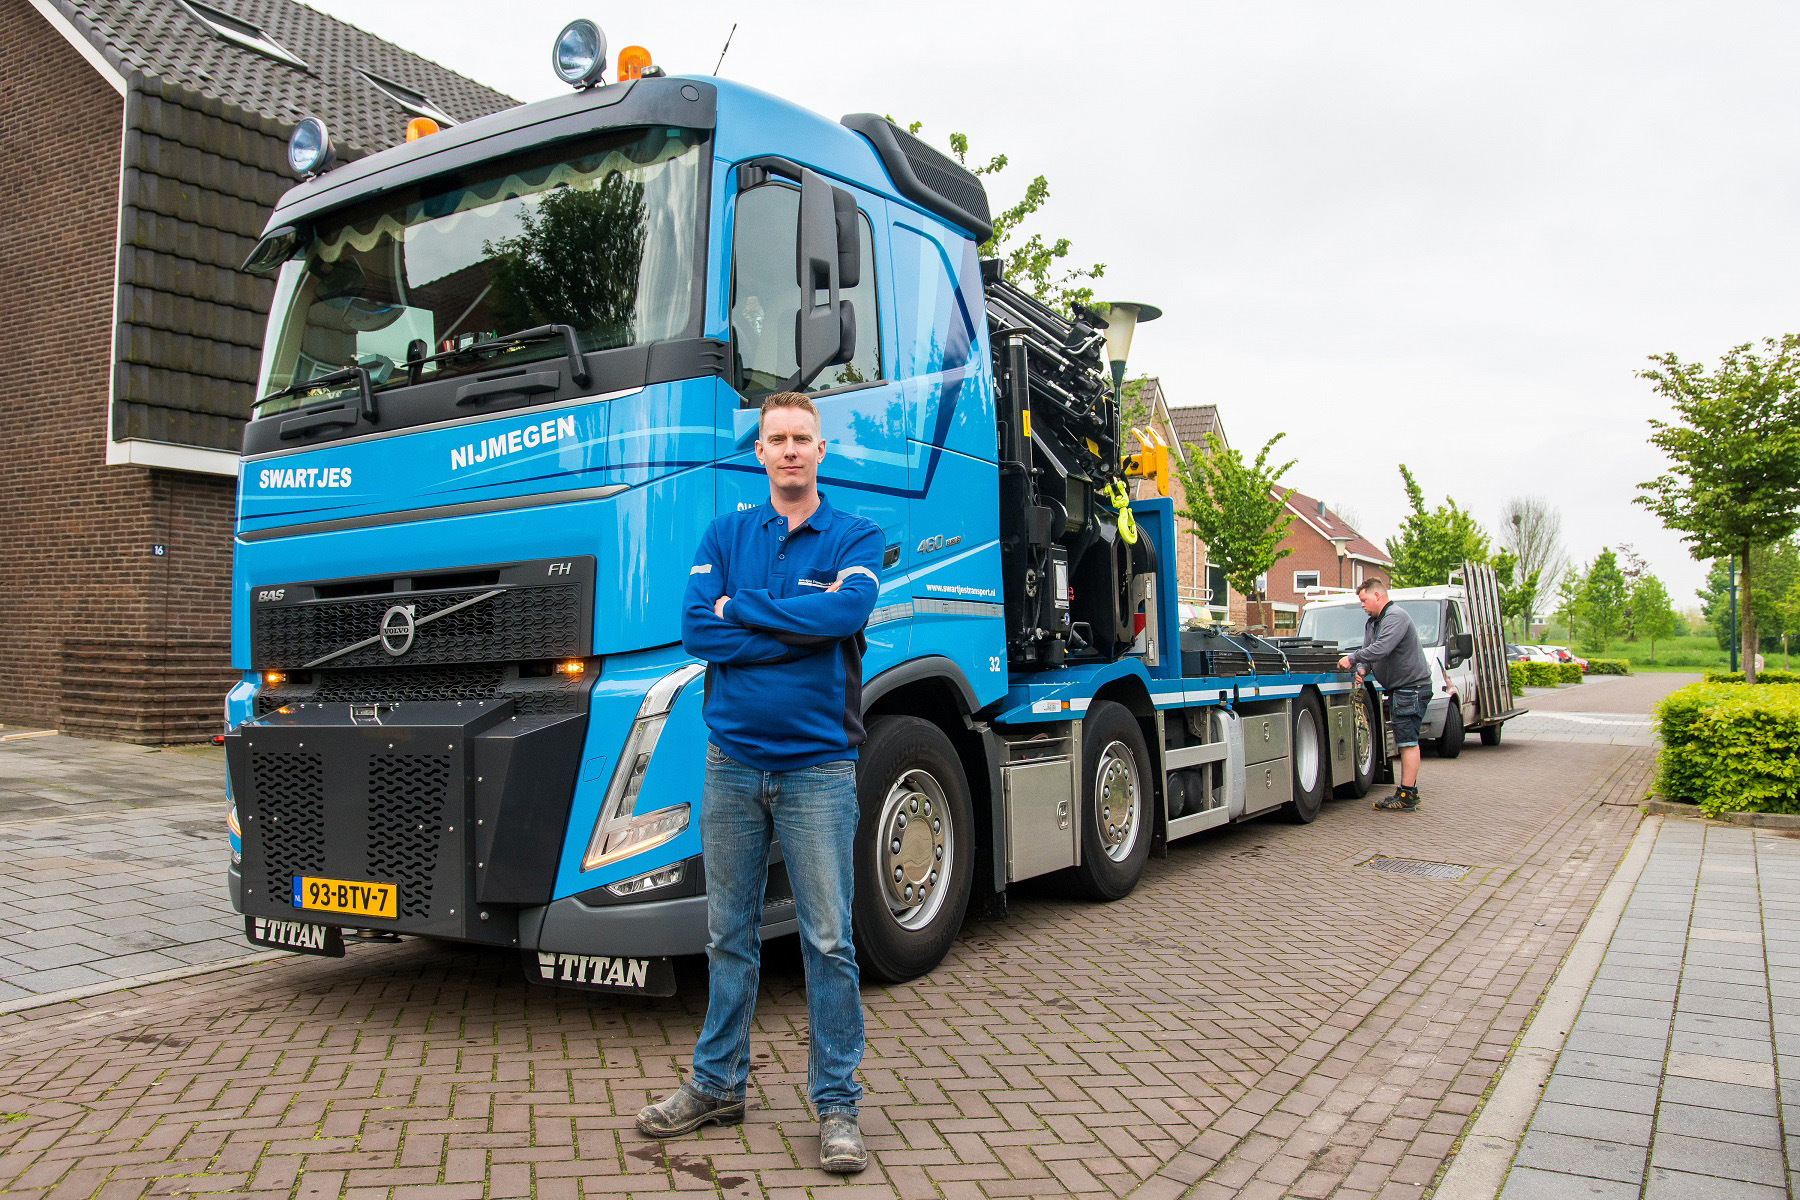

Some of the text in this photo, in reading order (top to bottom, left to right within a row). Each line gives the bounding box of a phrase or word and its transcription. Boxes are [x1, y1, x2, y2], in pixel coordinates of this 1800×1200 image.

[451, 415, 575, 470] NIJMEGEN
[259, 467, 352, 488] SWARTJES
[154, 545, 164, 555] 16
[917, 534, 944, 554] 460
[548, 562, 571, 576] FH
[258, 589, 285, 602] BAS
[926, 584, 996, 597] www.swartjestransport.nl
[989, 656, 1000, 672] 32
[309, 882, 389, 912] 93-BTV-7
[267, 919, 327, 950] TITAN
[559, 953, 649, 988] TITAN
